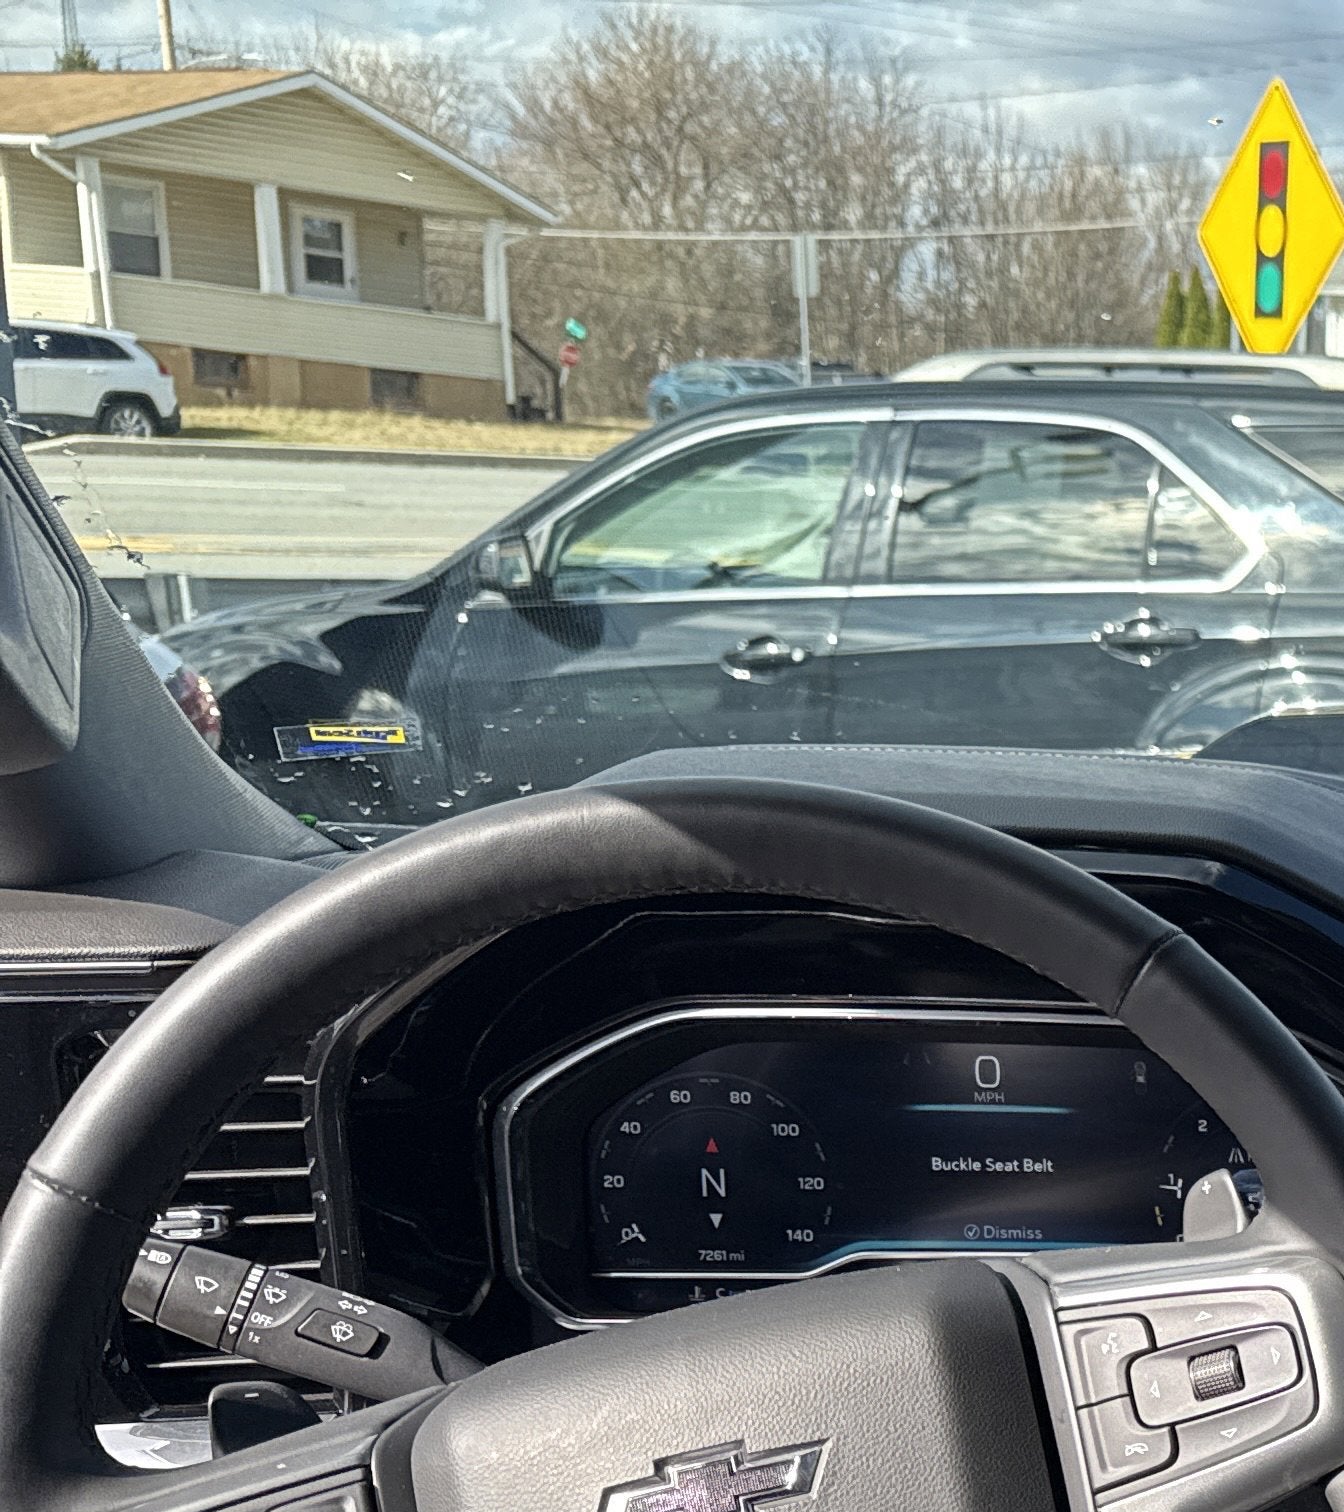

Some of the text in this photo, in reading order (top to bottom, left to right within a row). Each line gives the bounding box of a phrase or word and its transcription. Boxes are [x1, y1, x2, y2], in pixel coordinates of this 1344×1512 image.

[974, 1055, 1001, 1088] 0
[670, 1090, 691, 1103] 60
[729, 1091, 751, 1104] 80
[974, 1092, 1005, 1103] MPH
[620, 1122, 641, 1134] 40
[771, 1124, 800, 1137] 100
[1198, 1120, 1208, 1132] 2
[931, 1156, 1054, 1173] Buckle Seat Belt
[603, 1175, 625, 1188] 20
[701, 1168, 726, 1197] N
[798, 1177, 824, 1190] 120
[786, 1229, 814, 1242] 140
[983, 1225, 1043, 1240] Dismiss
[698, 1250, 745, 1261] 7261 mi
[250, 1312, 274, 1327] OFF
